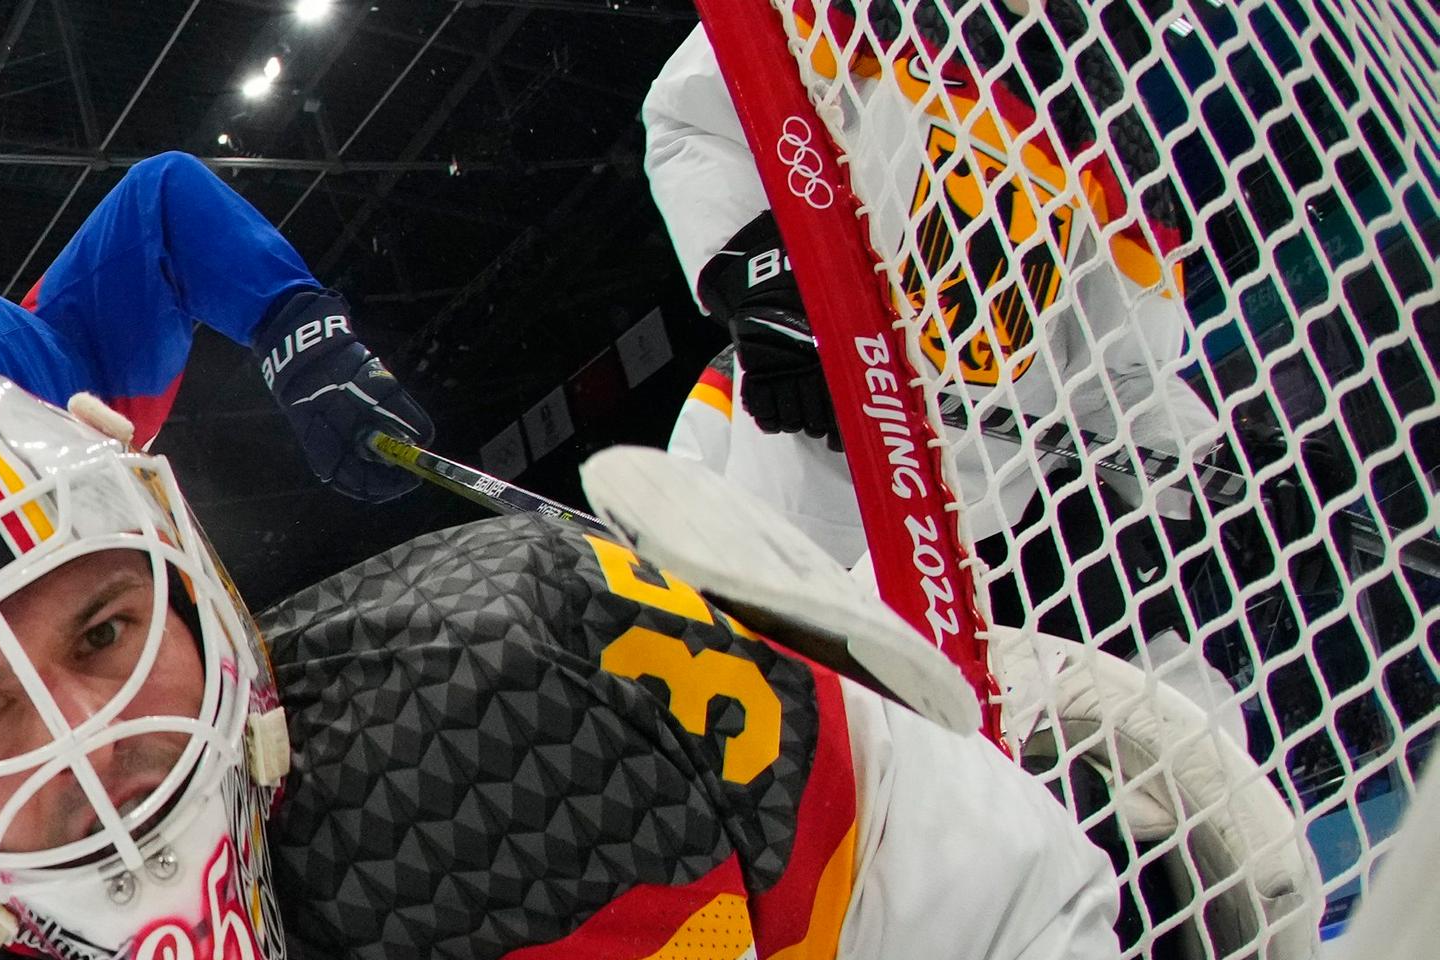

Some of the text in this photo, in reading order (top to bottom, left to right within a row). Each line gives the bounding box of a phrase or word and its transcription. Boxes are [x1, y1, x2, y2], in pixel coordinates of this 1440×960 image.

[748, 248, 792, 288] B
[473, 476, 508, 498] BAUER
[854, 332, 960, 650] BEIJING 2022
